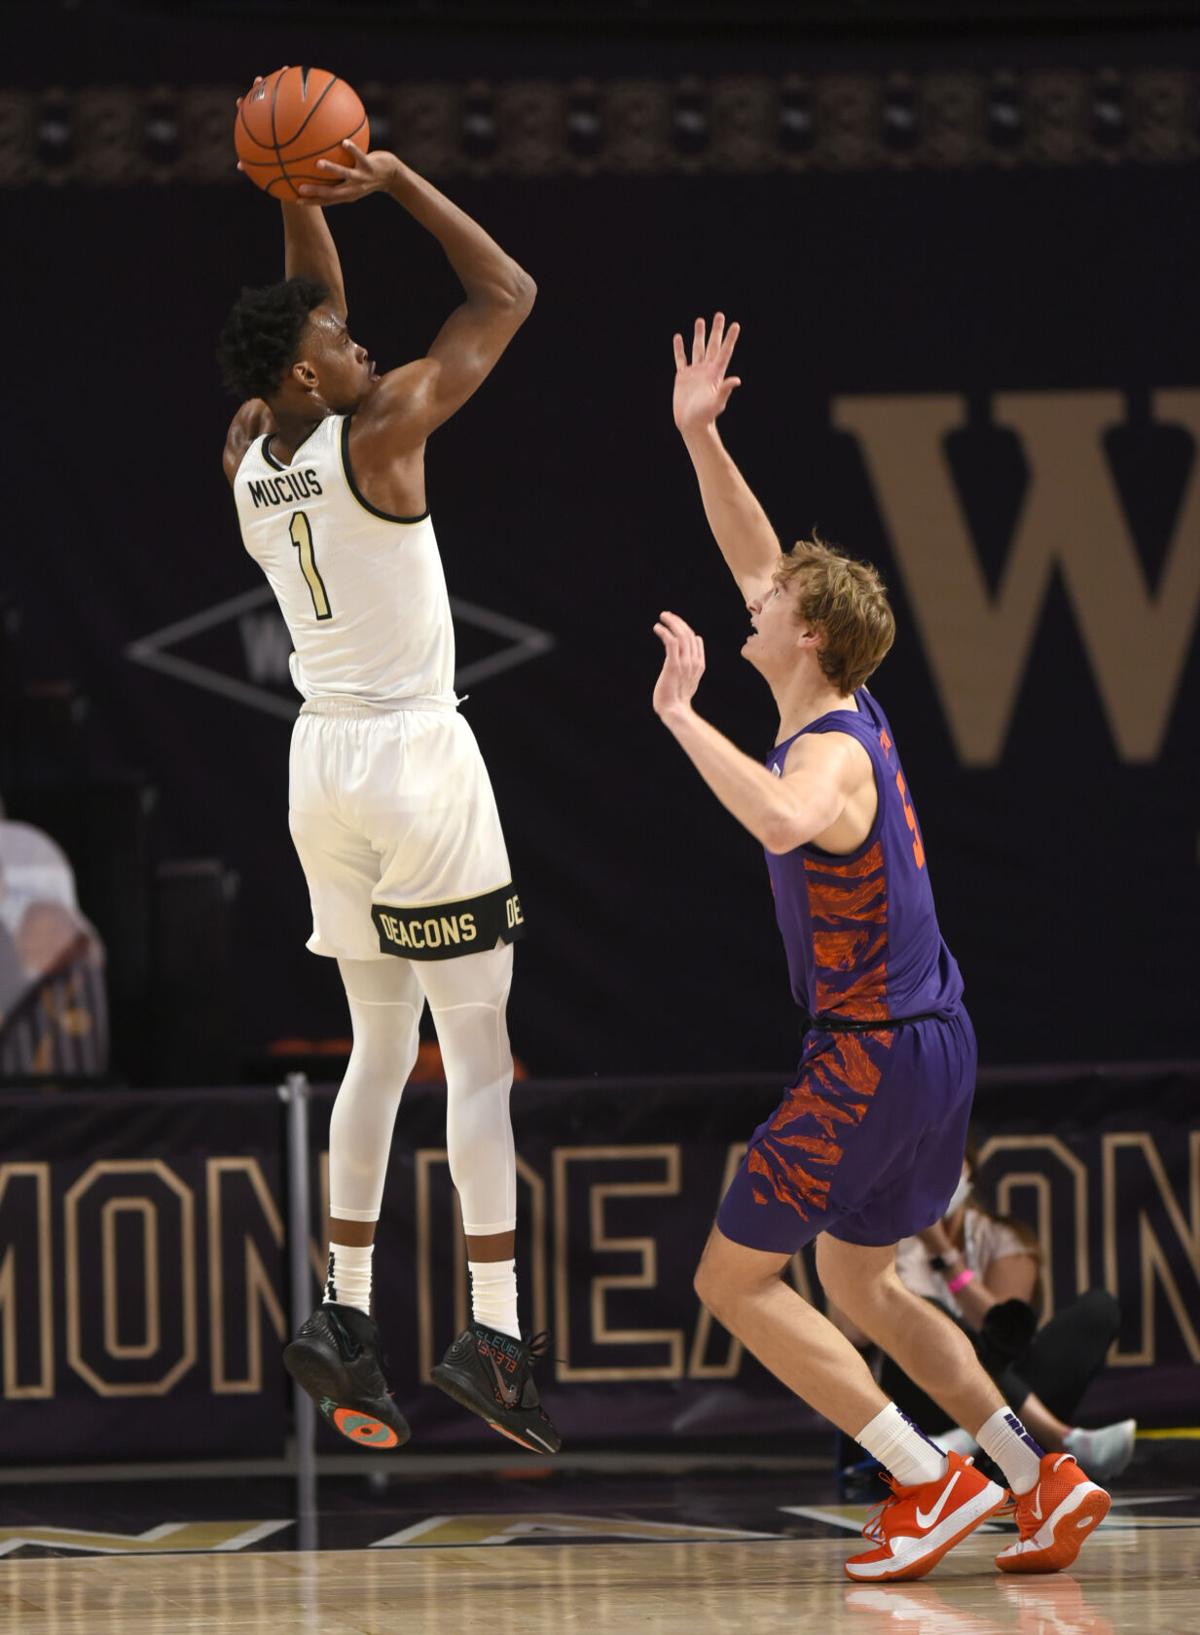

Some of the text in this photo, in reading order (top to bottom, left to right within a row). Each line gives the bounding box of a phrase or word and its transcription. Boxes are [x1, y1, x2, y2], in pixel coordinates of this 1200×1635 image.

[247, 469, 323, 508] MUCIUS
[288, 511, 333, 621] 1
[379, 913, 478, 949] DEACONS
